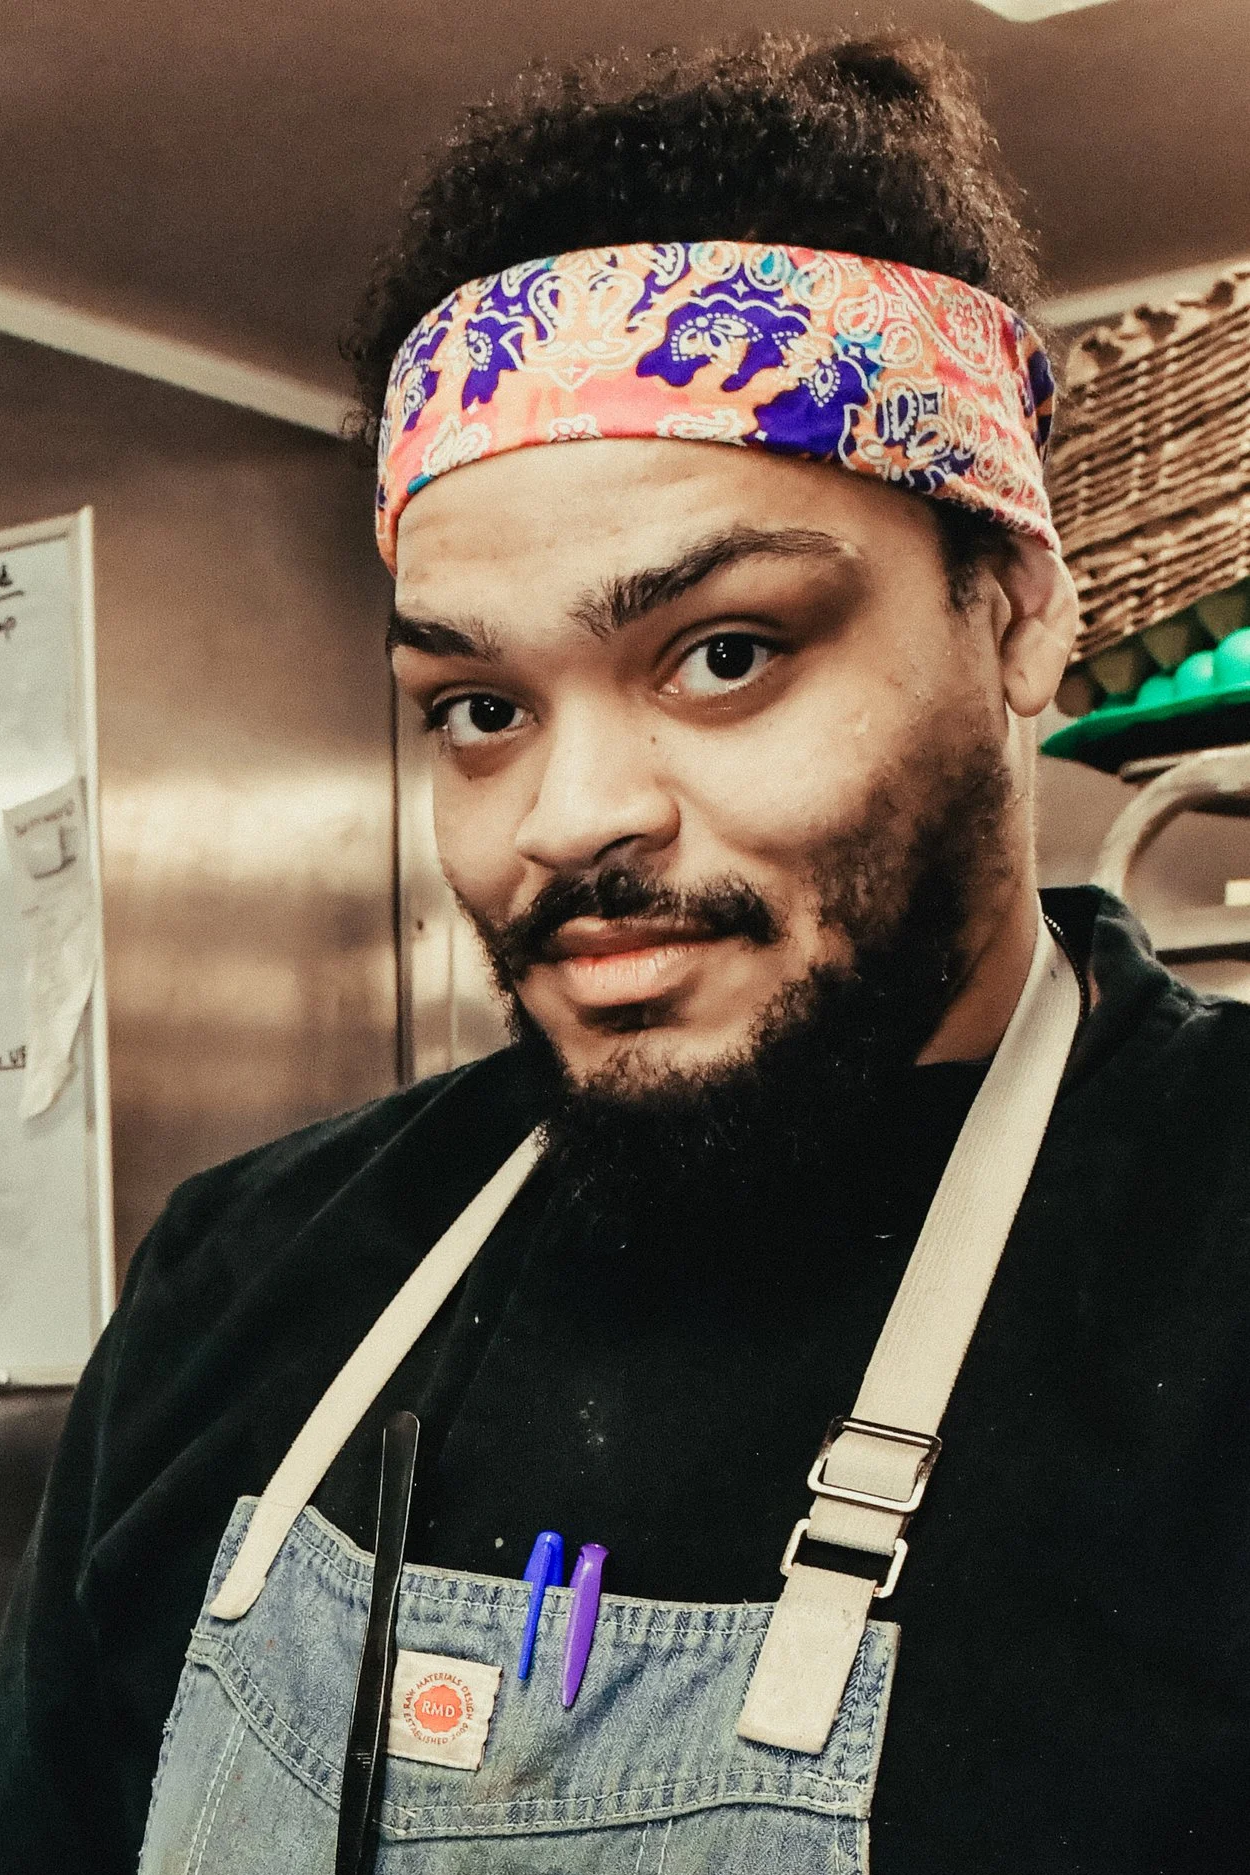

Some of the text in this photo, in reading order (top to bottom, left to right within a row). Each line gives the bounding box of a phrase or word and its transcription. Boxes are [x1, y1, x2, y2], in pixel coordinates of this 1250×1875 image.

[403, 1672, 475, 1720] RAW MATERIALS DESIGN
[421, 1700, 456, 1718] RMD
[403, 1712, 449, 1745] ESTABLISHED
